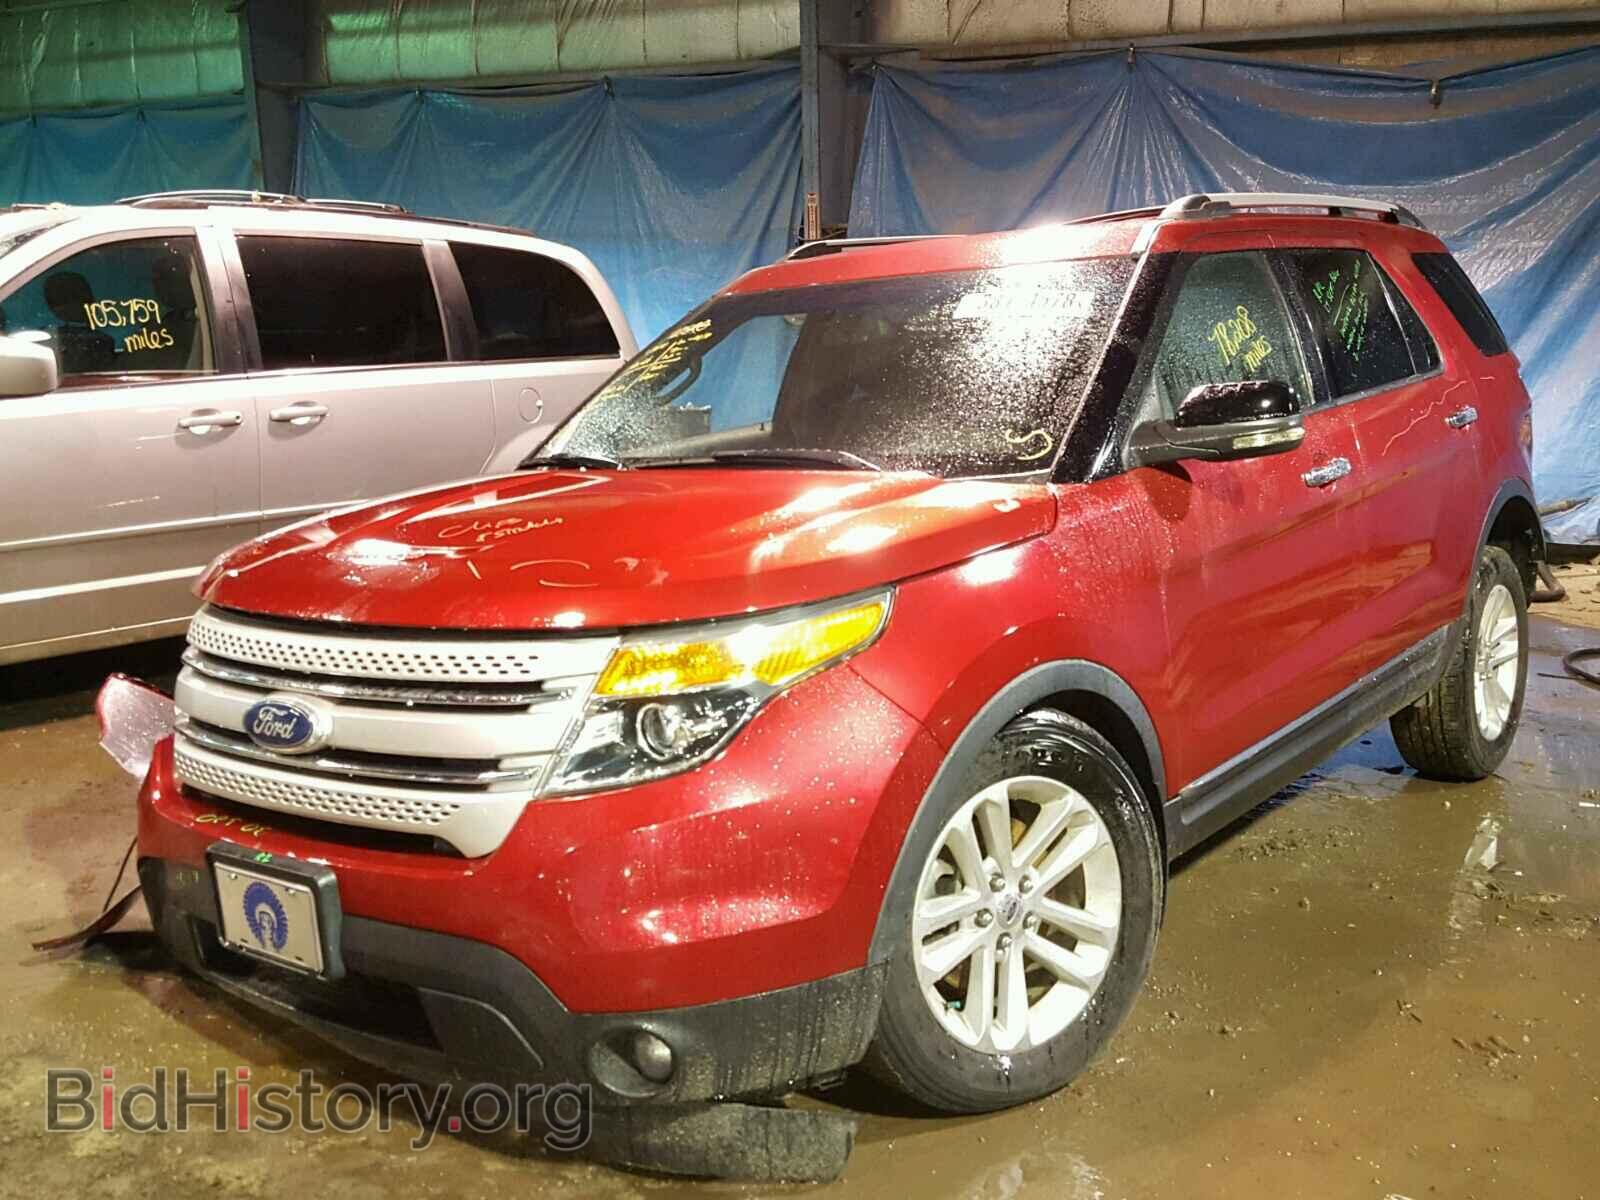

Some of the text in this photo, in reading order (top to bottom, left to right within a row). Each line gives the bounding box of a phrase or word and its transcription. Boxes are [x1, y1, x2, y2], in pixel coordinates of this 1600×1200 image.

[84, 298, 161, 331] 105,759
[124, 327, 175, 353] miles
[253, 705, 298, 740] Ford
